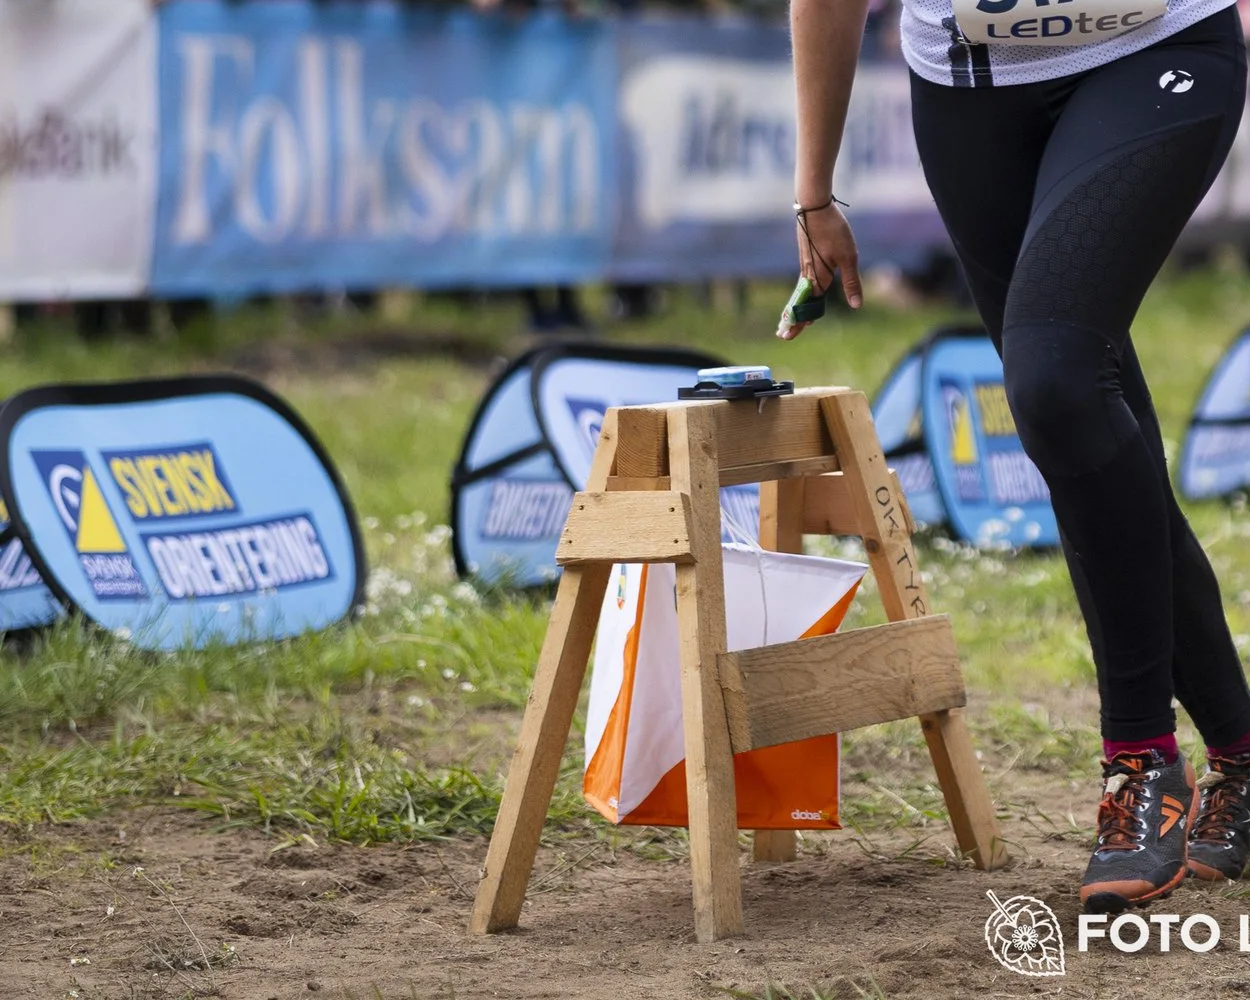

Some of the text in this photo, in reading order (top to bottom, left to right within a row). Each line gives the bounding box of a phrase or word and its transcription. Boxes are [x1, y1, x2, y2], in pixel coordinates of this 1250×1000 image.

[110, 448, 234, 518] SVENSK
[874, 485, 900, 539] OK
[146, 514, 330, 600] ORIENTERING
